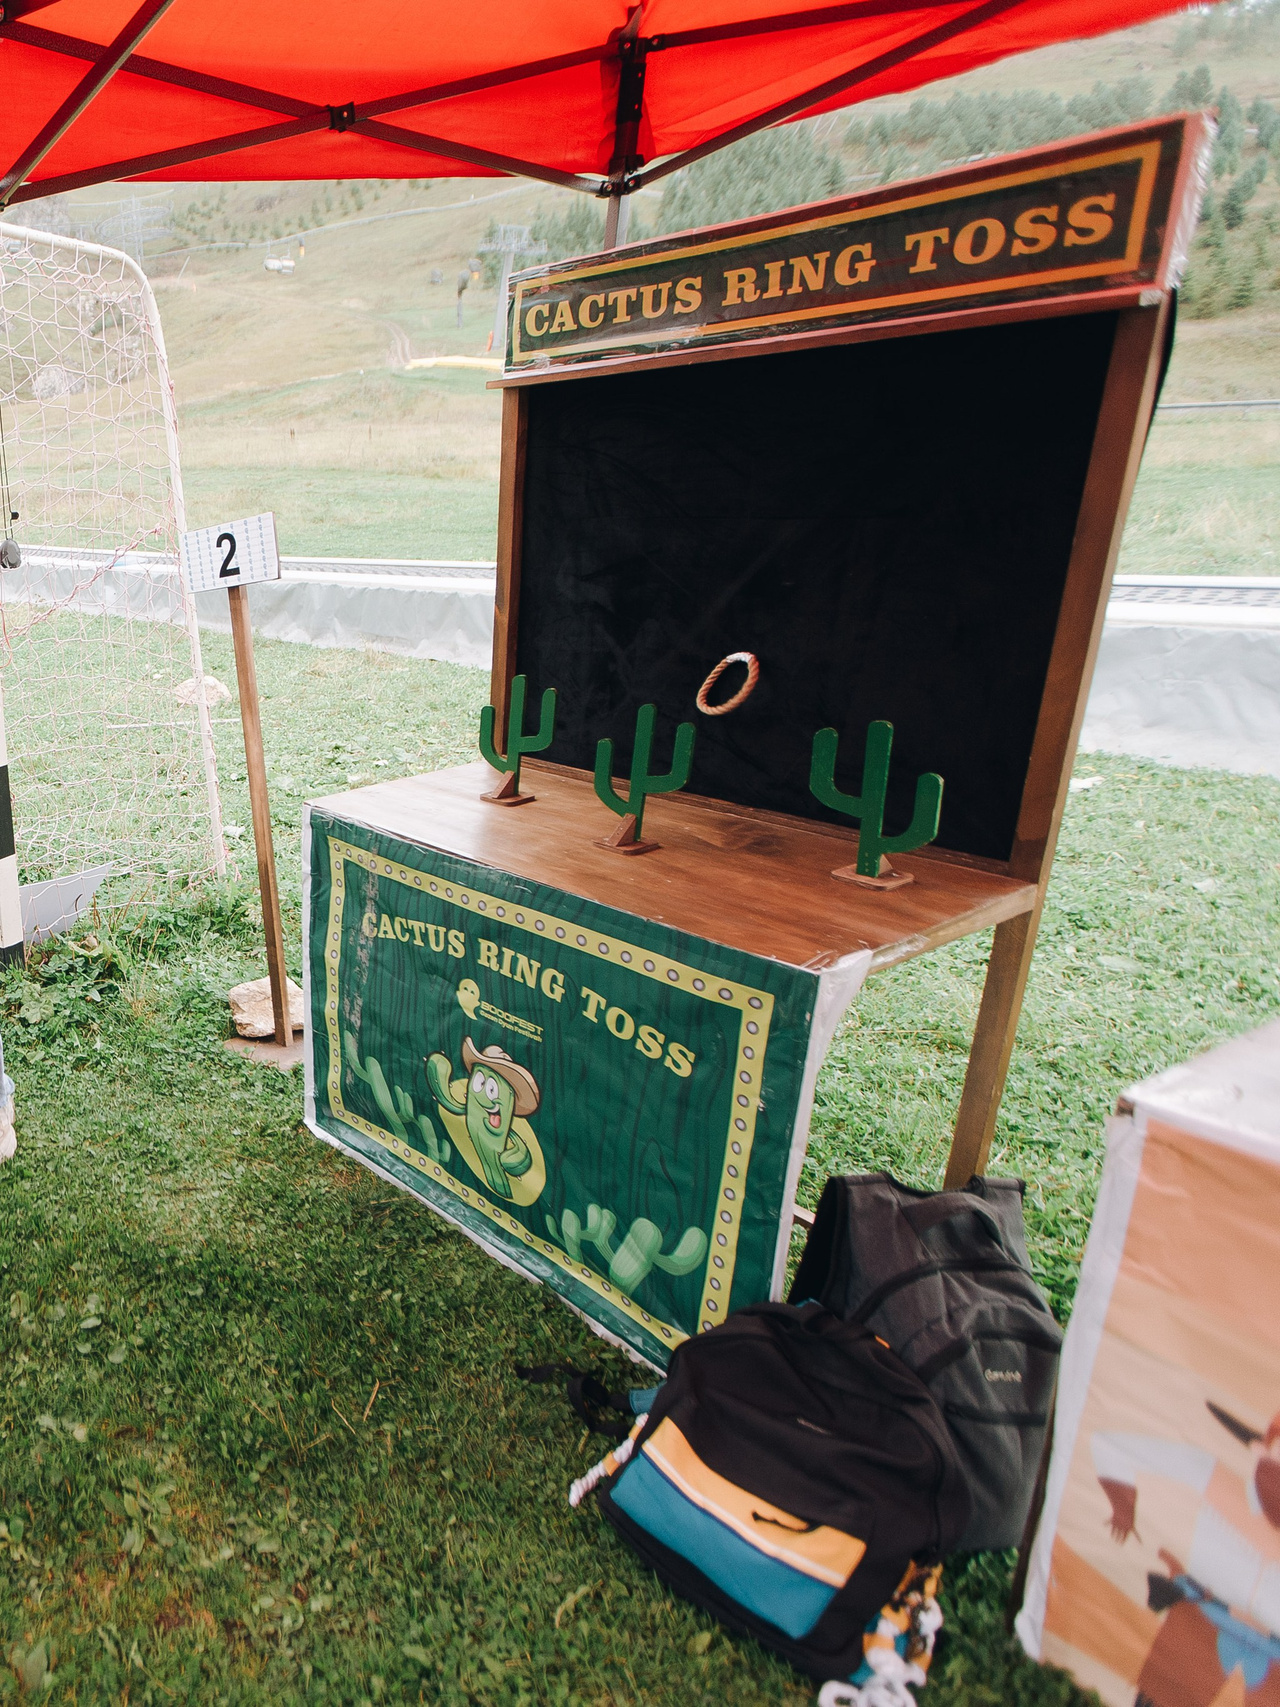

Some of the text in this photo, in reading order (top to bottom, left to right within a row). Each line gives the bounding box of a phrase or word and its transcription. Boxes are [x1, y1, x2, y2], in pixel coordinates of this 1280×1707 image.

[525, 193, 1117, 338] CACTUS RING TOSS
[216, 532, 240, 578] 2
[362, 912, 696, 1078] CACTUS RING TOSS
[480, 1000, 544, 1035] BOOOFEST
